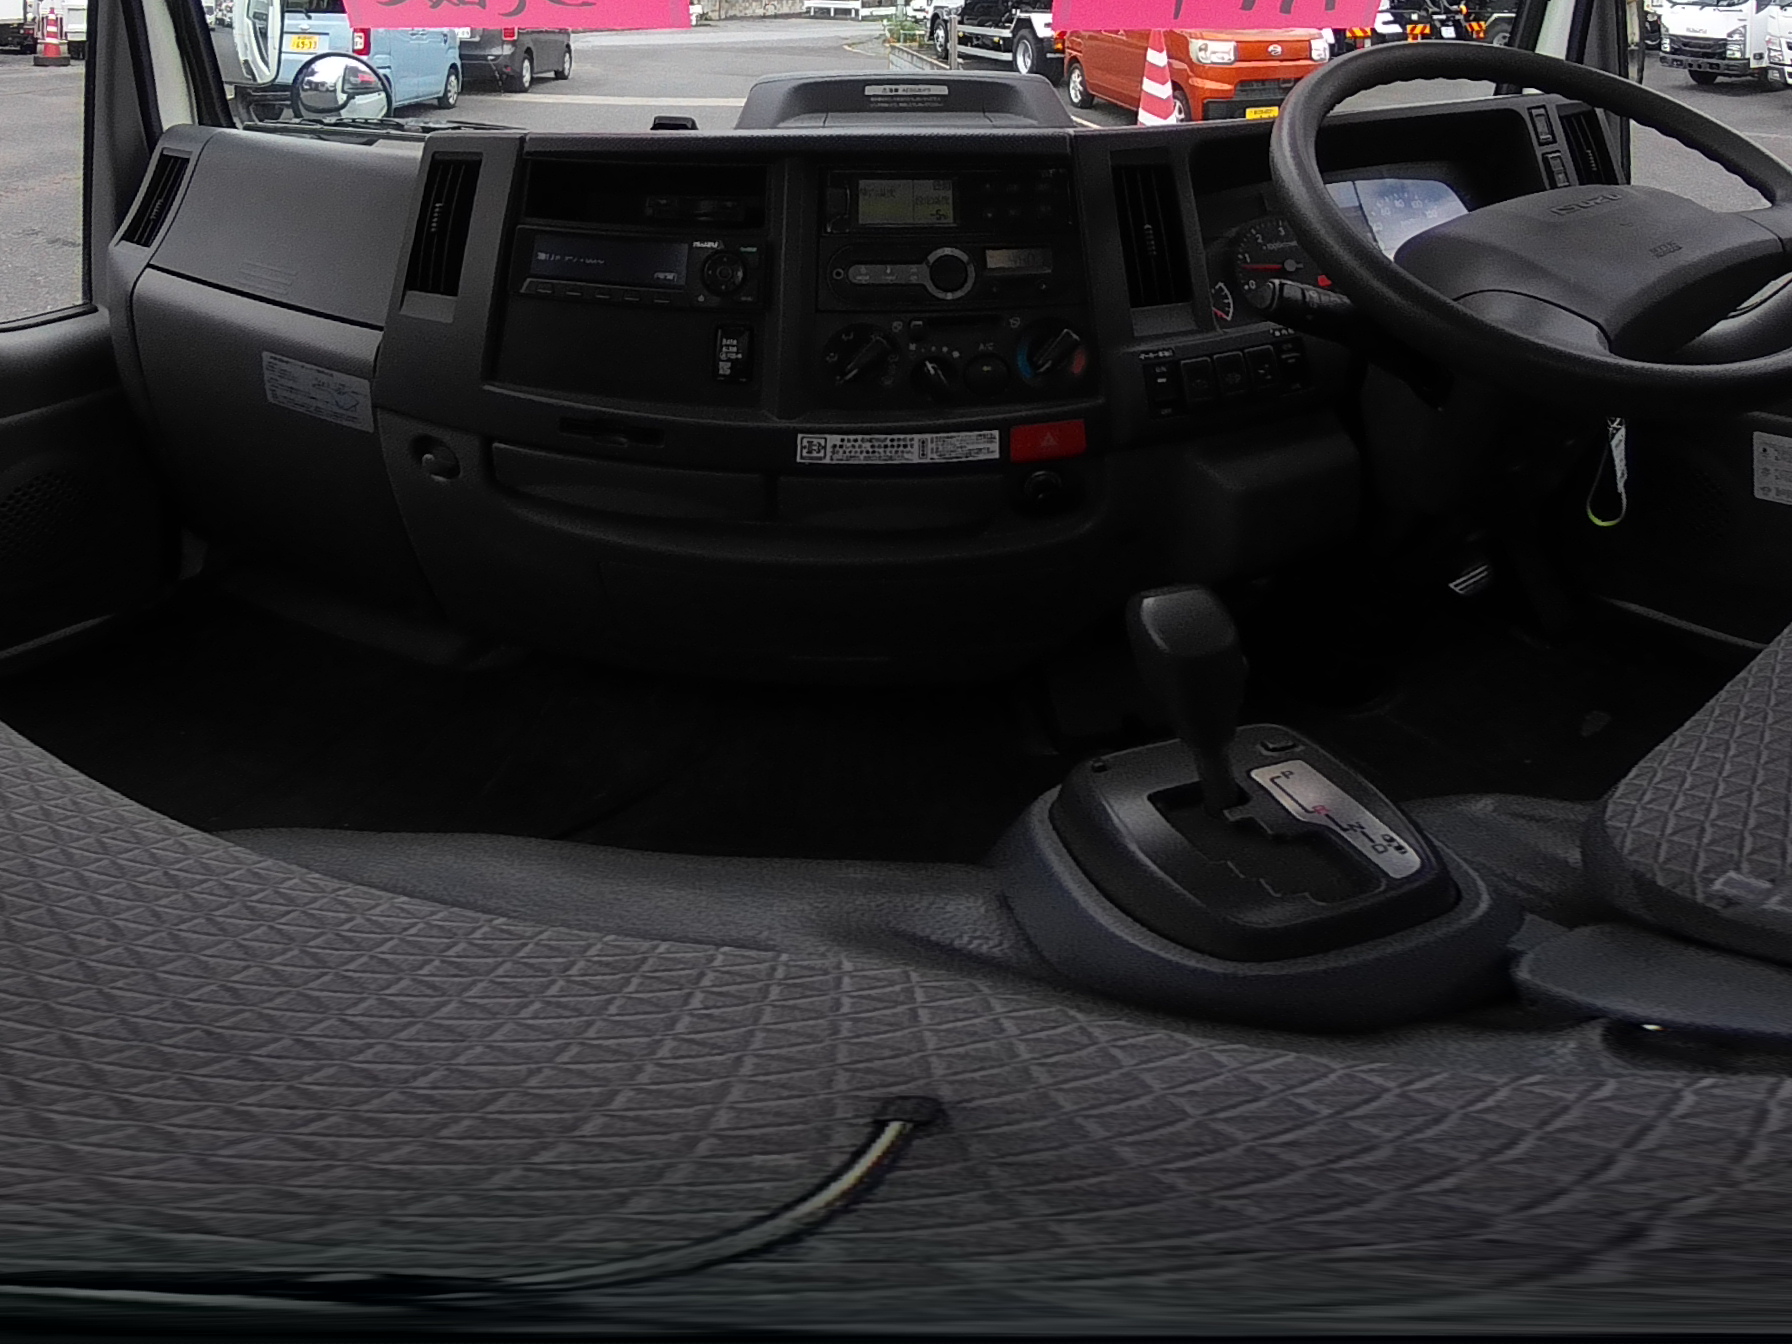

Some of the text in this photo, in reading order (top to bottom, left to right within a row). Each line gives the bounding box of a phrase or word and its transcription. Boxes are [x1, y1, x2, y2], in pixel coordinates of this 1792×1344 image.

[1278, 227, 1285, 236] 3
[1255, 233, 1263, 243] 2
[1280, 770, 1294, 780] P
[1373, 843, 1389, 855] D
